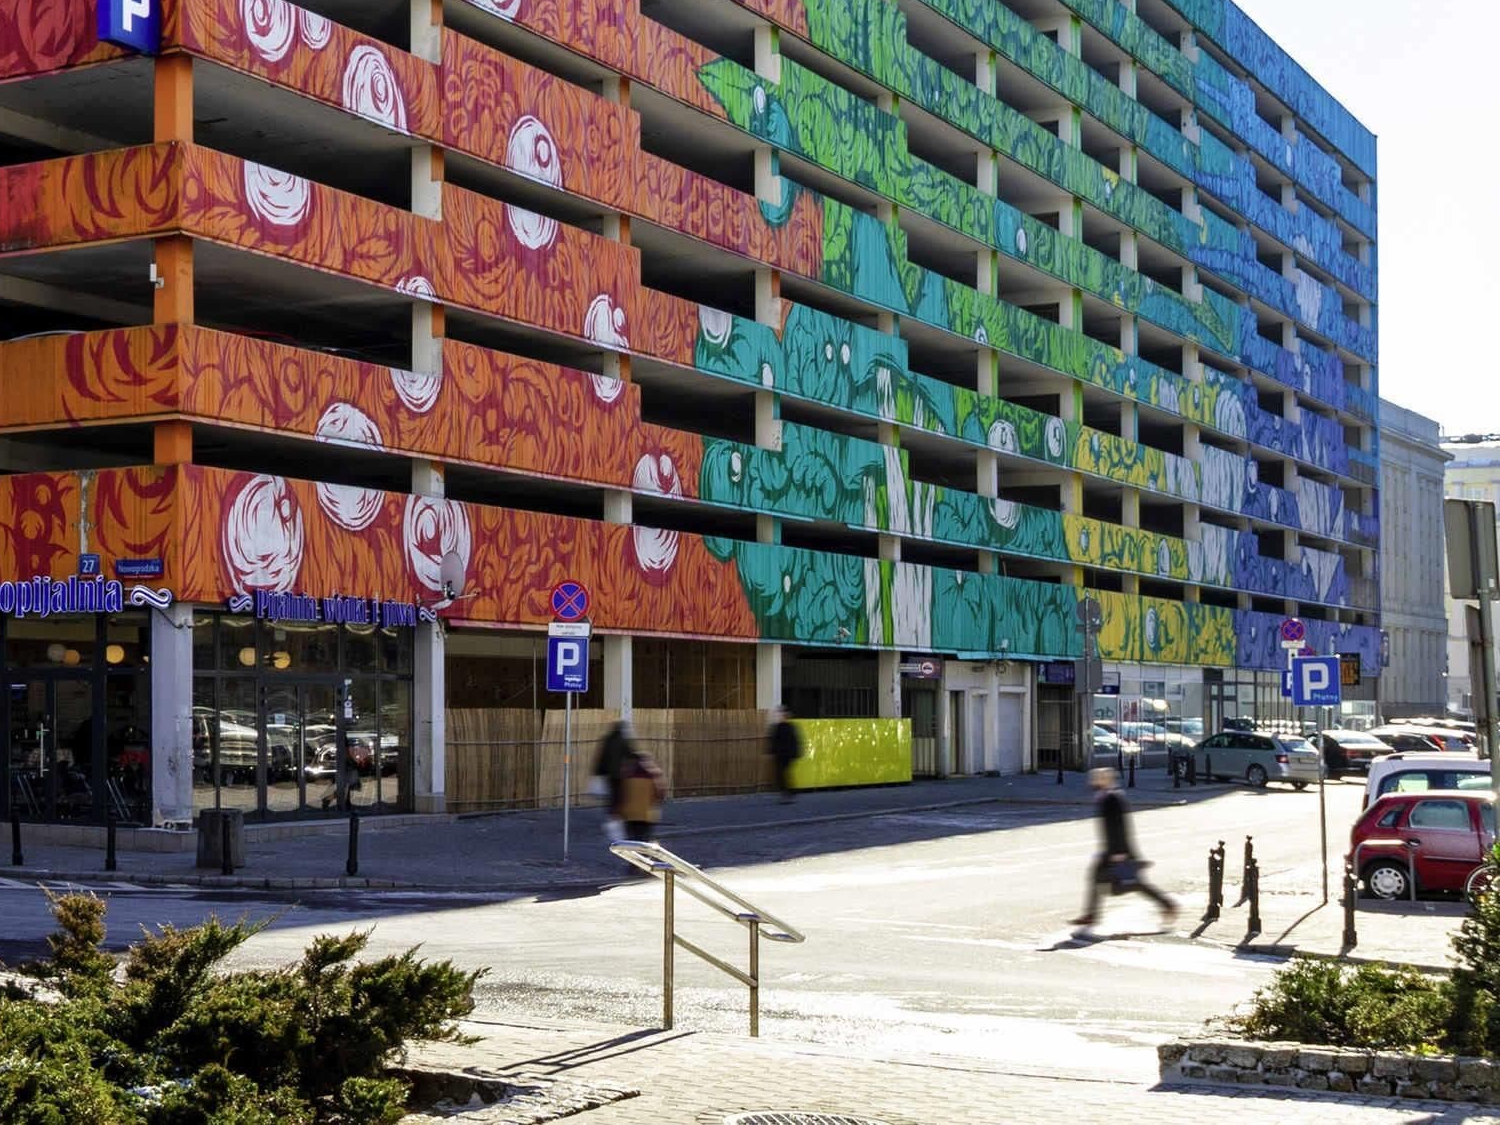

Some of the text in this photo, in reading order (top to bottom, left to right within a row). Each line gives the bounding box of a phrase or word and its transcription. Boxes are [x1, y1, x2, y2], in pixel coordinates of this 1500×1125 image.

[82, 560, 95, 573] 27
[557, 642, 580, 676] P
[1302, 663, 1329, 701] P
